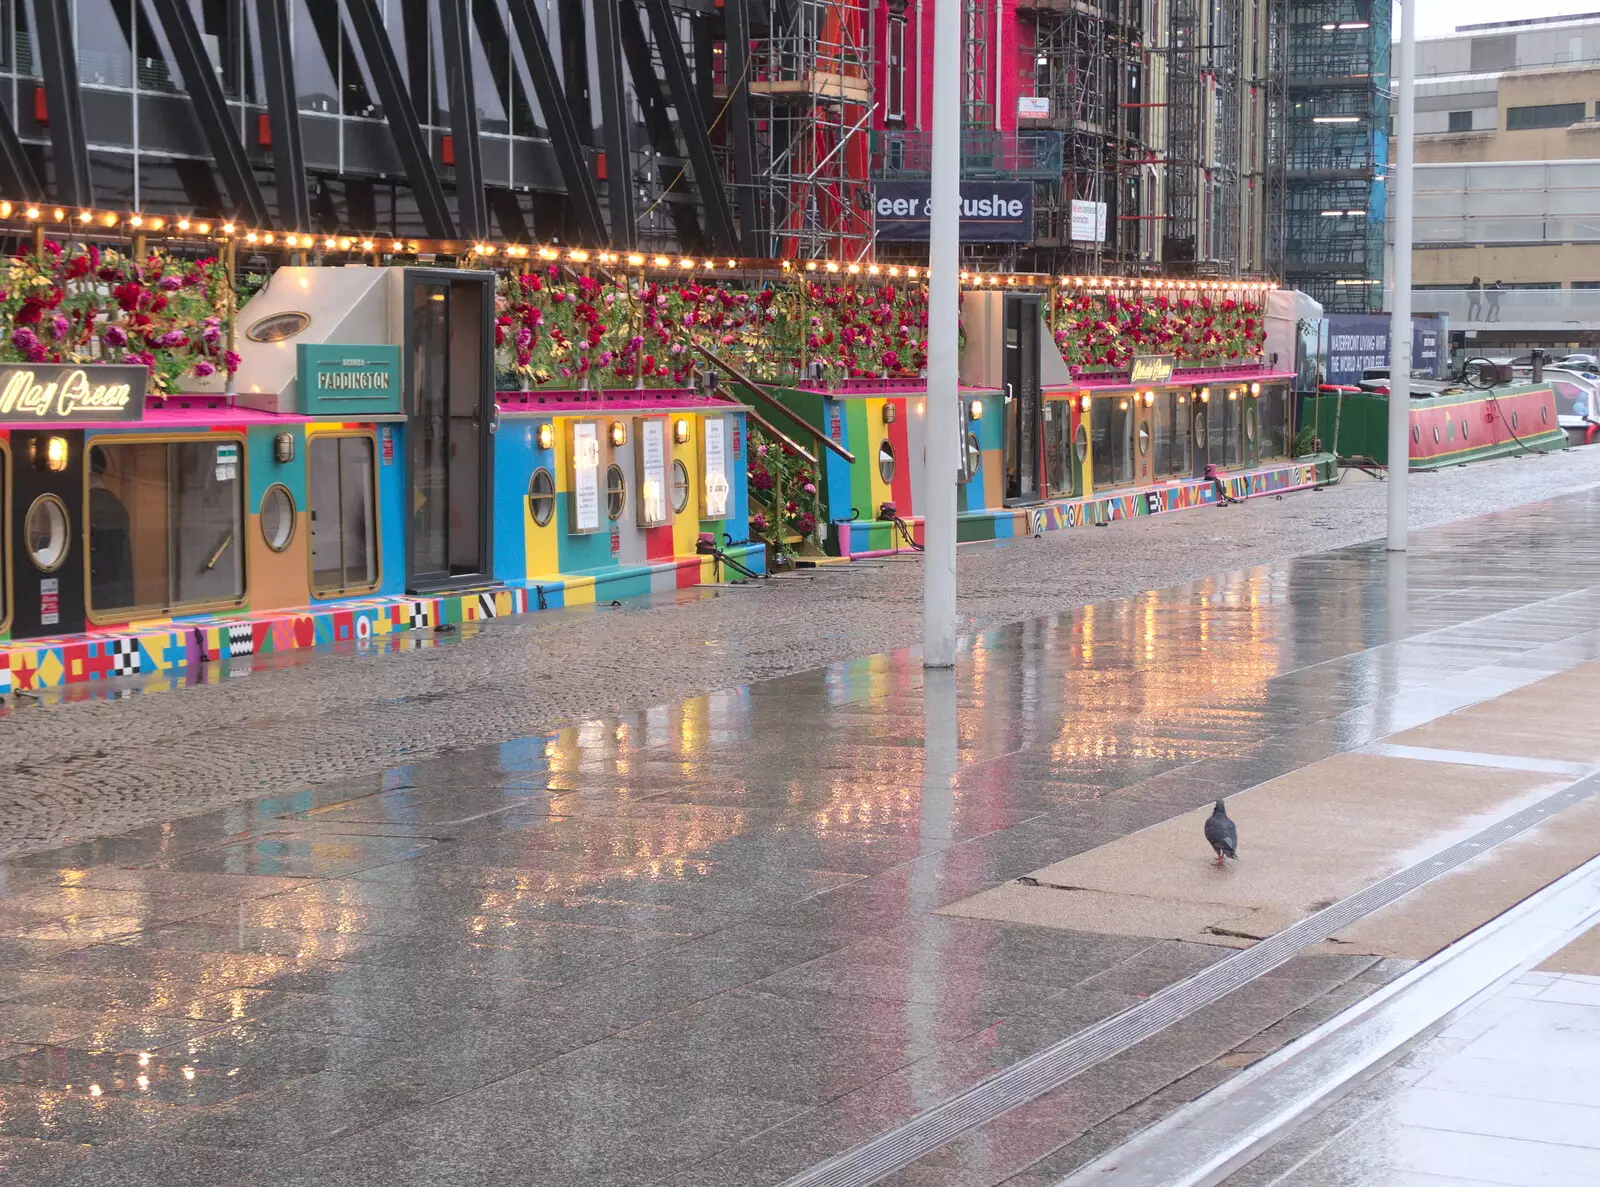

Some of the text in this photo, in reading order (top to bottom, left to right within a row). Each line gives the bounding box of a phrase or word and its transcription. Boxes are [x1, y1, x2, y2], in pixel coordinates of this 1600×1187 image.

[877, 198, 919, 216] eer
[1331, 335, 1359, 351] WATERFRONT
[1360, 335, 1375, 350] LIVING
[1331, 356, 1339, 373] THE
[1340, 356, 1356, 372] WORLD
[318, 371, 389, 389] PADDINGTON
[0, 370, 131, 416] May Green
